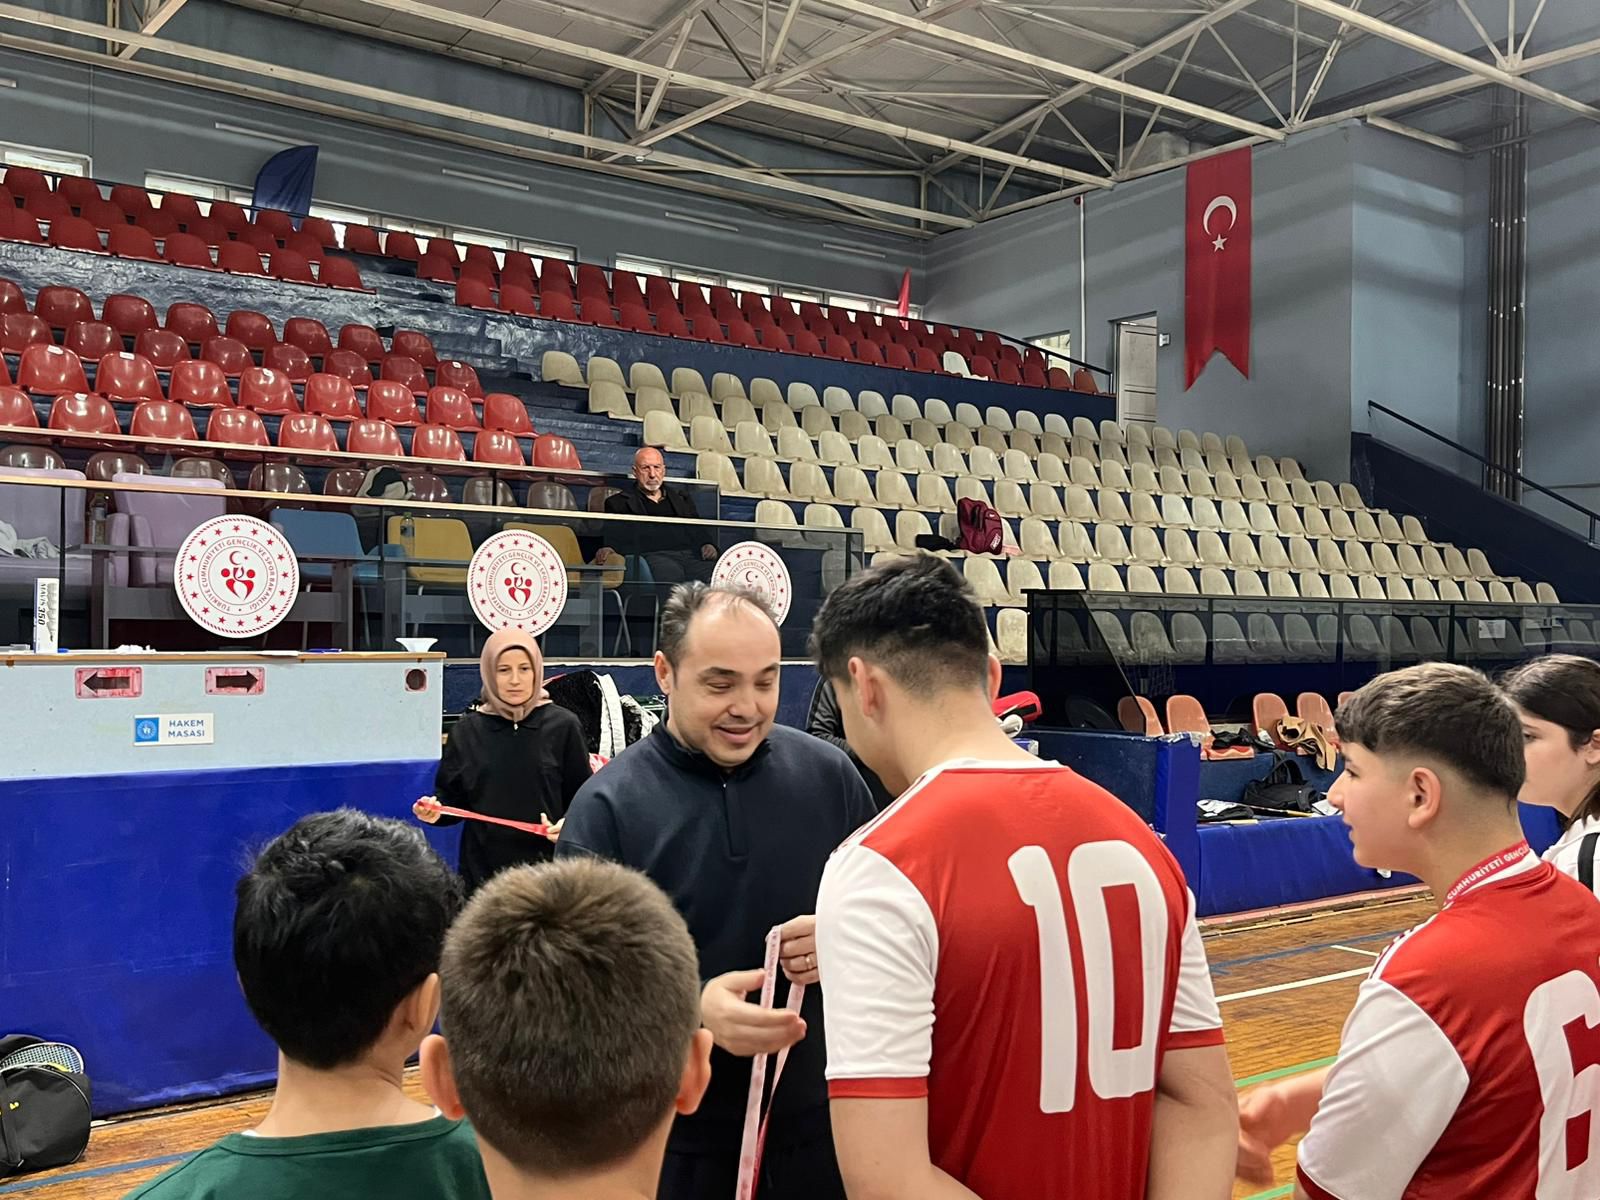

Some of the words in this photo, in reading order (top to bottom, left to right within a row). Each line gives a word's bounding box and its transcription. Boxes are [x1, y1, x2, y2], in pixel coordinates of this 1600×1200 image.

[258, 546, 265, 556] VE
[264, 557, 275, 576] SPOR
[38, 606, 46, 625] 350
[168, 729, 205, 738] MASASI
[169, 719, 204, 728] HAKEM
[1446, 856, 1504, 900] CUMHURİYETİ
[1007, 839, 1168, 1114] 10
[1523, 969, 1600, 1200] 6
